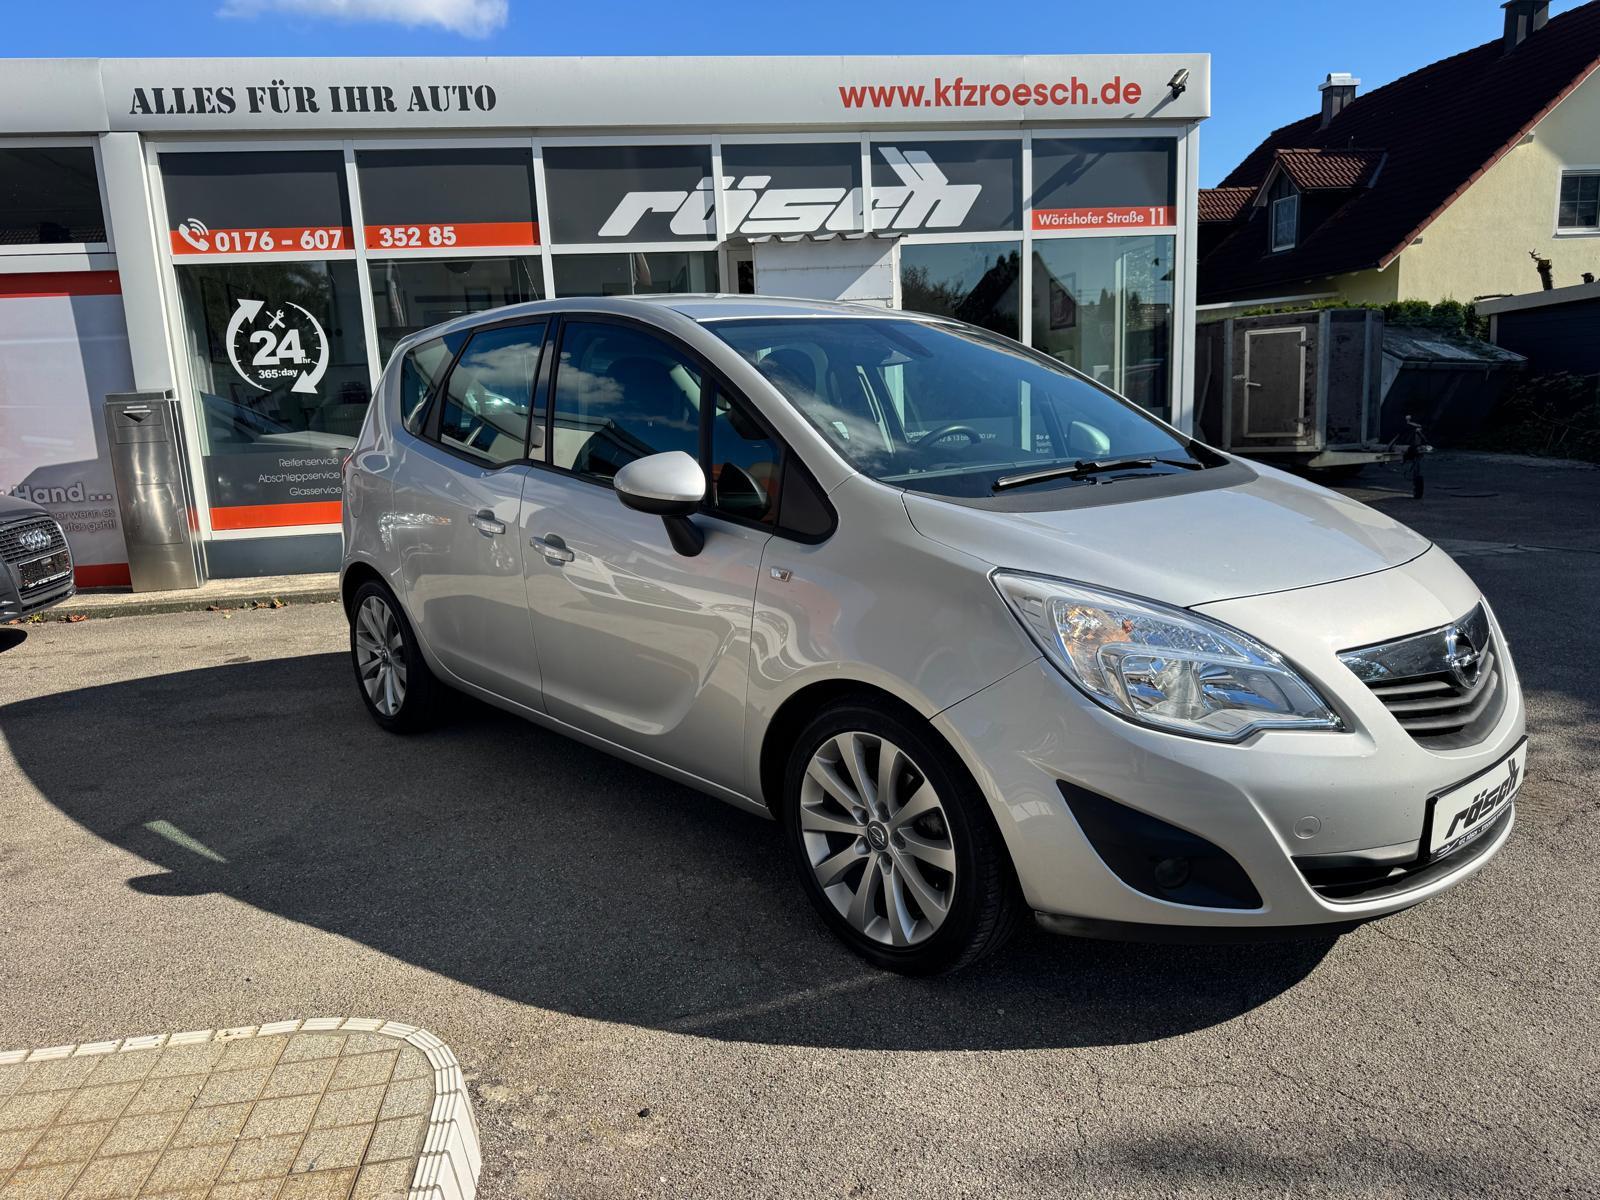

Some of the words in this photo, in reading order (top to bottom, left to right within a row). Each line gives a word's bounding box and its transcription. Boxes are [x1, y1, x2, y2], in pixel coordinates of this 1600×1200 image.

[129, 86, 237, 115] ALLES
[246, 79, 320, 114] FÜR
[328, 85, 398, 113] IHR
[406, 84, 497, 113] AUTO
[838, 76, 1142, 108] www.kfzroesch.de
[1038, 212, 1104, 226] Wörishofer
[1106, 210, 1145, 223] Straße
[1149, 207, 1165, 225] 11
[214, 231, 275, 252] 0176
[300, 229, 343, 250] 607
[379, 226, 422, 247] 352
[428, 226, 457, 246] 85
[249, 328, 306, 366] 24
[258, 368, 298, 379] 365:day
[279, 458, 339, 467] Reifenservice
[258, 472, 340, 483] Abschleppservice
[12, 482, 84, 503] Hand
[289, 486, 342, 496] Glasservice
[71, 510, 99, 519] wenn
[62, 523, 88, 532] utos
